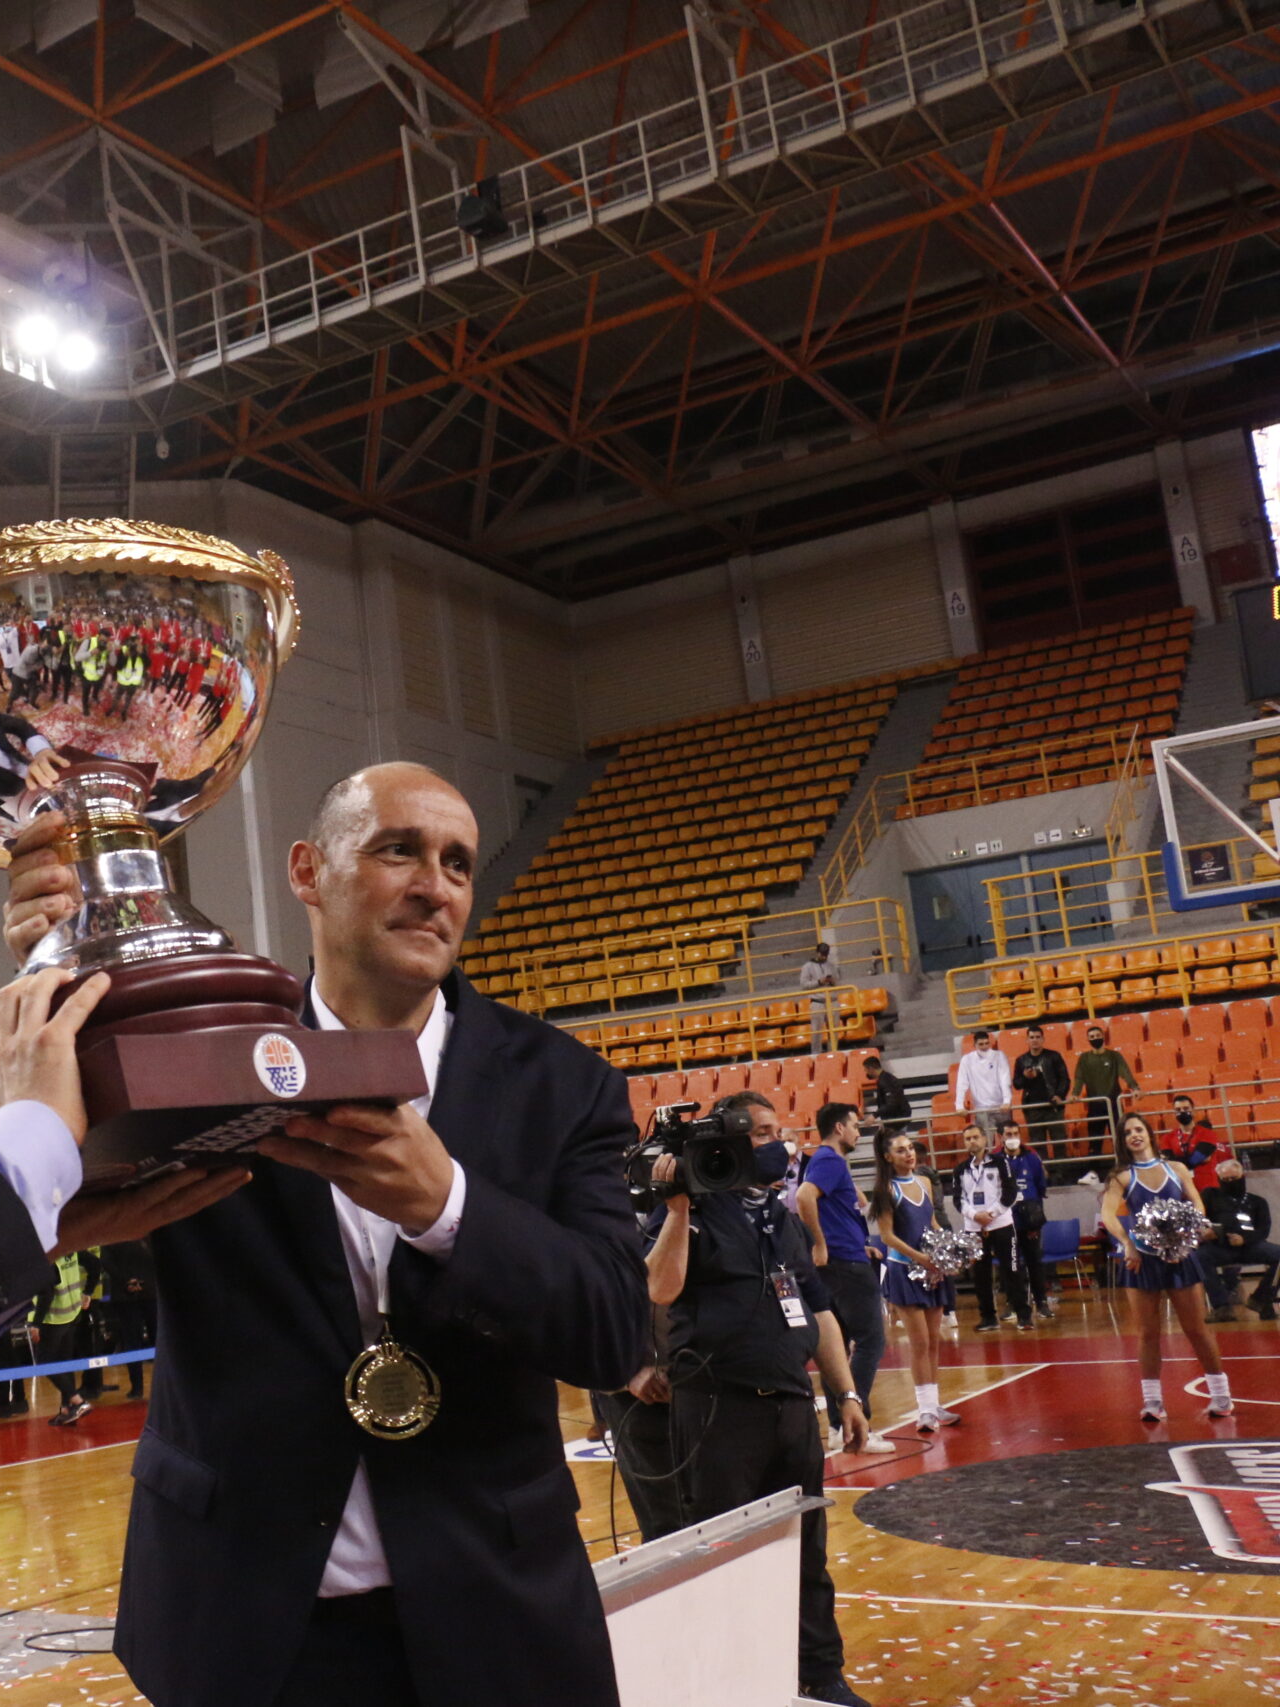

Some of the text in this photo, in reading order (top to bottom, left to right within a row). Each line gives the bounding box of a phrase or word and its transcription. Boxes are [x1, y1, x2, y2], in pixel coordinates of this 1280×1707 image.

[1181, 535, 1192, 549] A
[1180, 548, 1198, 562] 19
[951, 591, 962, 604] A
[951, 602, 966, 616] 19
[747, 640, 757, 650] A
[745, 650, 761, 664] 20
